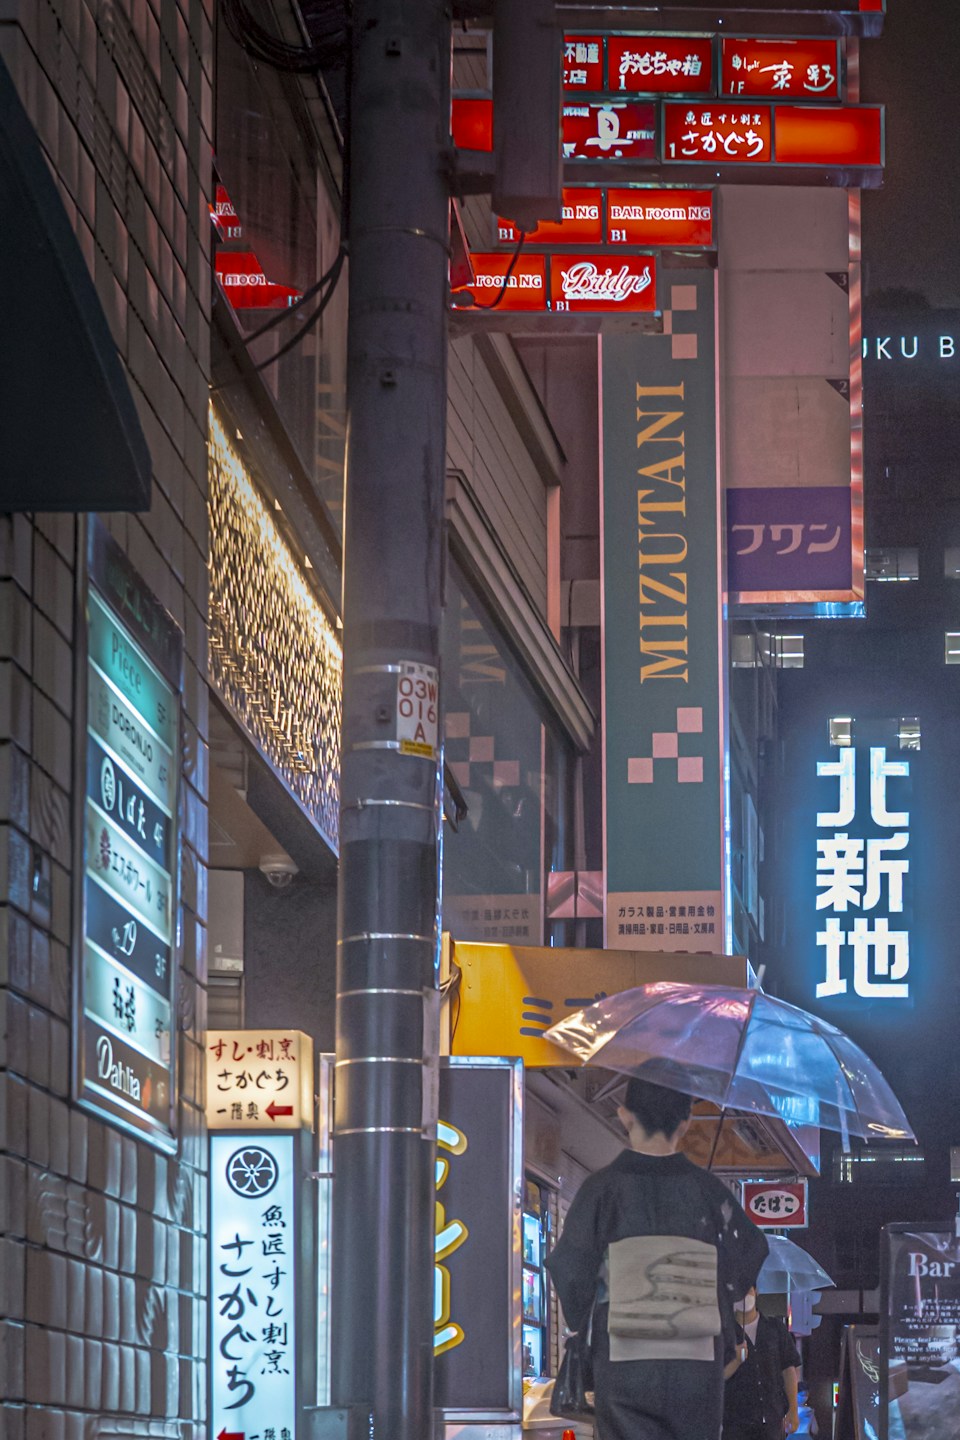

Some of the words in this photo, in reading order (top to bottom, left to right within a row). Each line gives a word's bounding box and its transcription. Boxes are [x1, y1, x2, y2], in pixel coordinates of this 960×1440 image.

[619, 51, 702, 76] おもちゃ箱
[681, 129, 765, 157] さかぐち
[576, 206, 599, 219] NG
[610, 206, 643, 220] BAR
[645, 207, 686, 220] room
[688, 207, 711, 220] NG
[499, 228, 515, 241] B1
[611, 230, 628, 243] B1
[520, 275, 543, 288] NG
[561, 262, 652, 301] Bridge
[556, 300, 571, 312] B1
[636, 381, 689, 684] MIZUTANI
[815, 747, 910, 999] 北新地
[209, 1038, 296, 1062] すし・割烹
[96, 1035, 141, 1102] Dahlia
[217, 1068, 289, 1091] さかぐち
[216, 1101, 259, 1121] 一階奥
[908, 1252, 956, 1278] Bar
[219, 1232, 259, 1410] さかぐち
